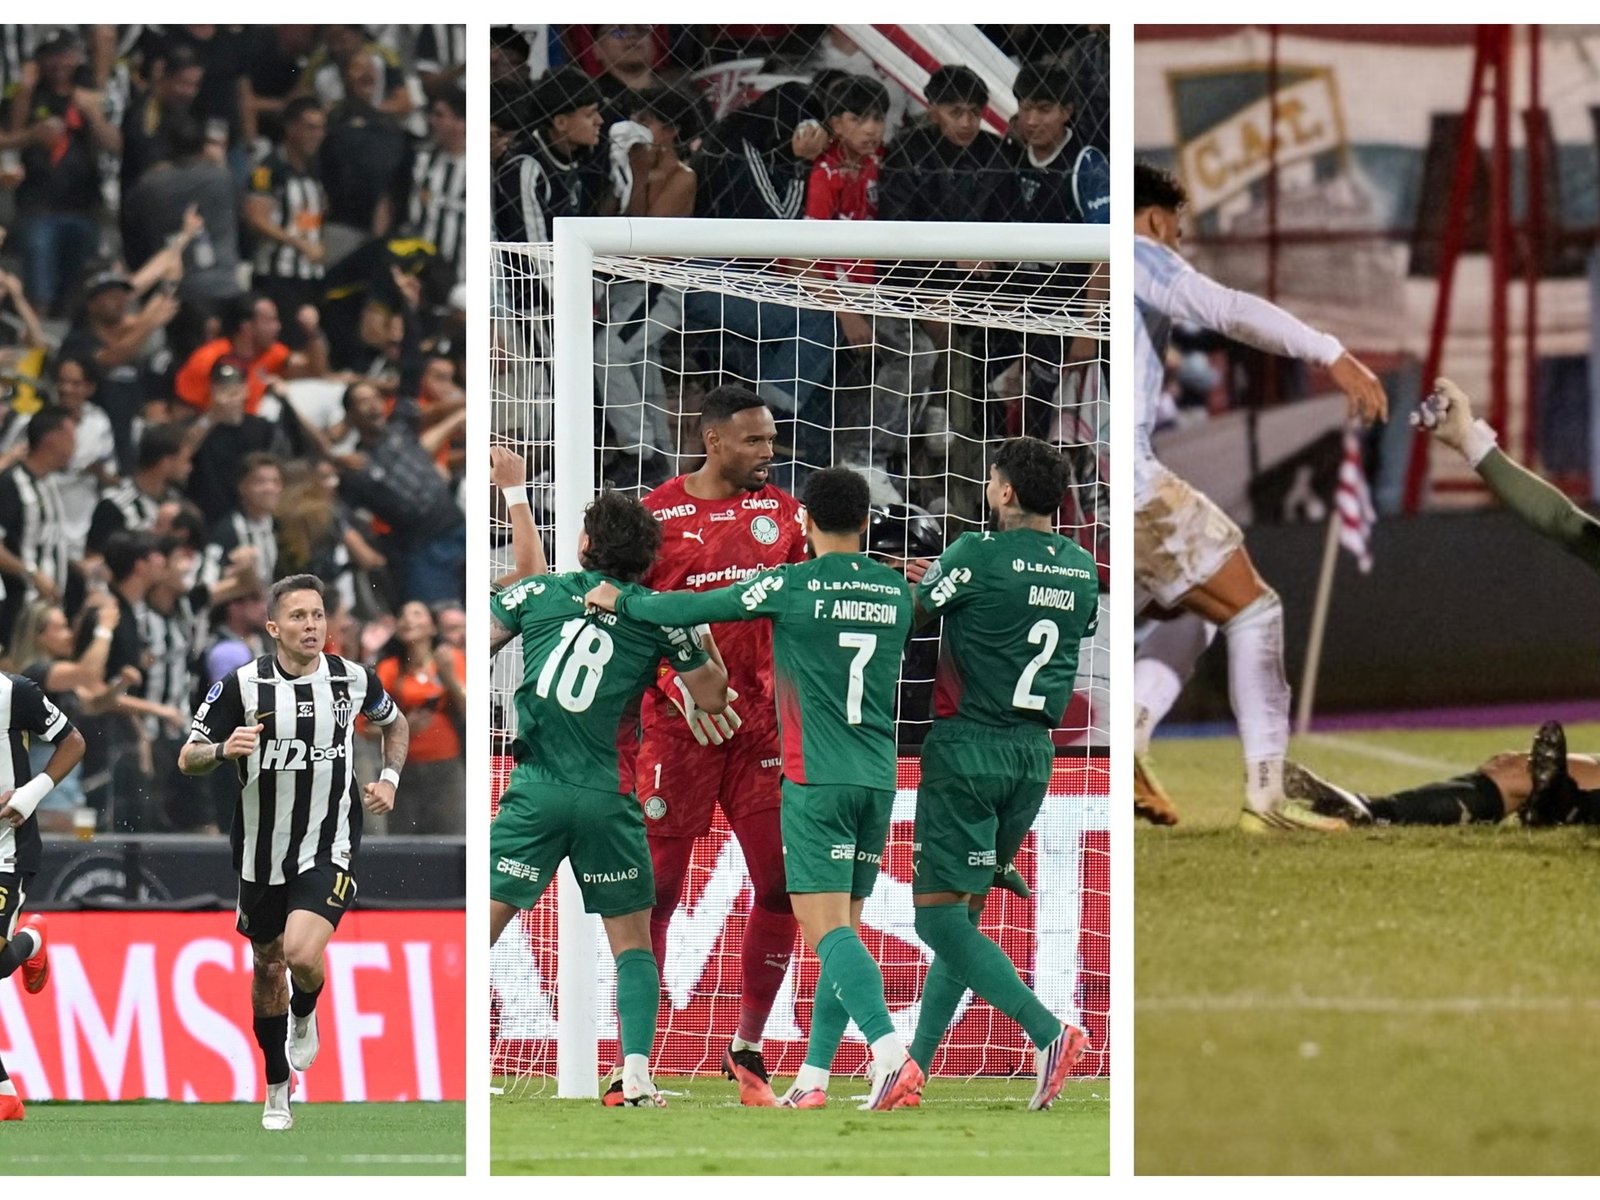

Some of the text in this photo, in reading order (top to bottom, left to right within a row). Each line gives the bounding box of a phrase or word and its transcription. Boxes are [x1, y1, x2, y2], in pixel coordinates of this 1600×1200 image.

[652, 503, 697, 522] CIMED
[741, 498, 779, 510] CIMED
[1027, 562, 1091, 580] LEAPMOTOR
[823, 581, 901, 596] LEAPMOTOR
[1028, 585, 1075, 611] BARBOZA
[814, 599, 897, 624] F. ANDERSON
[536, 618, 614, 713] 18
[1012, 619, 1060, 711] 2
[838, 632, 877, 725] 7
[654, 763, 662, 789] 1
[496, 861, 540, 882] CHEFE
[509, 858, 531, 870] MOTO
[333, 872, 350, 901] 11
[583, 870, 628, 884] D'ITALIA
